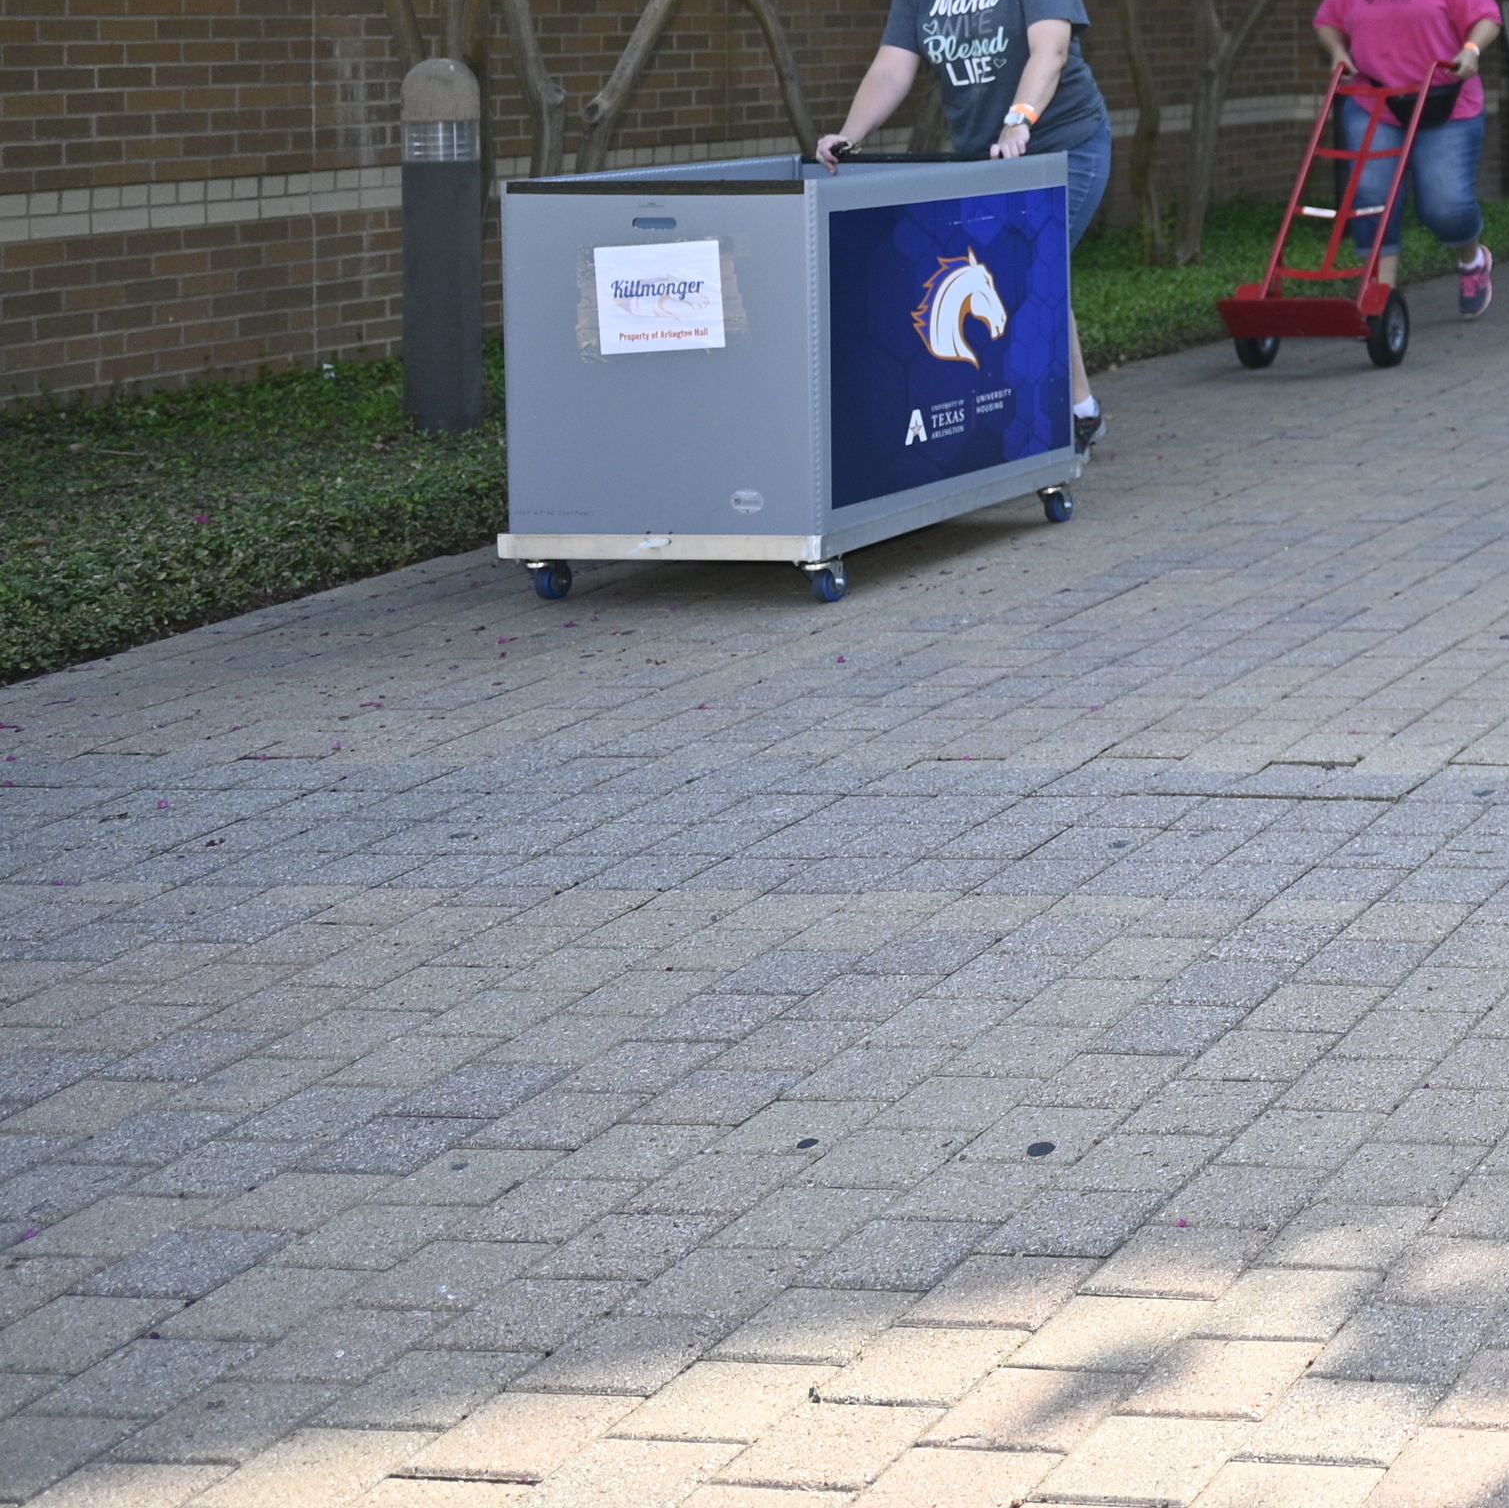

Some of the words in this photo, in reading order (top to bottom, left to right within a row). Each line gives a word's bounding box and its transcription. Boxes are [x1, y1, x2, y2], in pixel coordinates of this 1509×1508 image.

[946, 56, 996, 86] LIFE
[611, 280, 704, 301] Killmonger
[619, 332, 649, 342] Property
[651, 331, 658, 339] of
[661, 330, 693, 340] Arlington
[694, 327, 708, 336] Hall
[976, 388, 1012, 404] UNIVERSITY
[976, 400, 1004, 414] HOUSING
[931, 408, 965, 428] TEXAS
[931, 425, 965, 439] ARLINGTON
